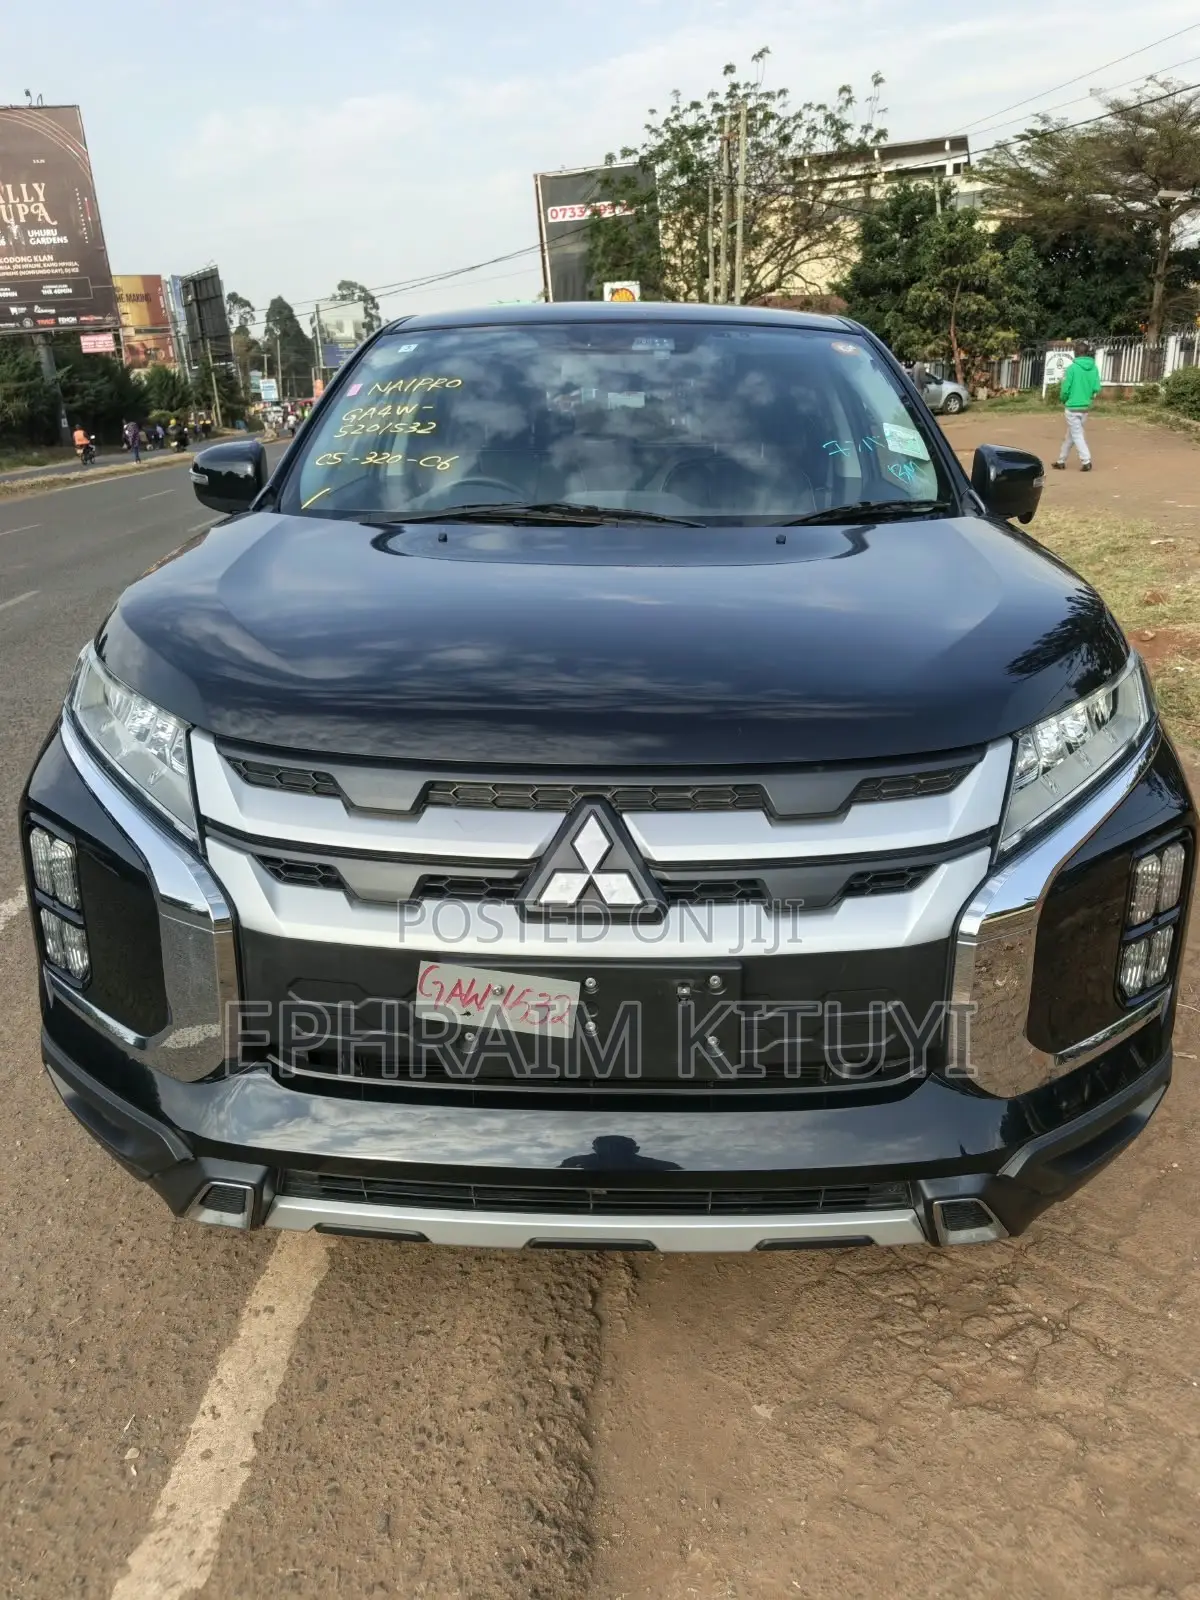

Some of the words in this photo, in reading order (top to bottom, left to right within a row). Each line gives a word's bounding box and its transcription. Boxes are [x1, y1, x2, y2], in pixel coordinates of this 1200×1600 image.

[28, 229, 57, 237] UHURU
[29, 236, 68, 245] GARDENS
[33, 254, 54, 263] KLAN
